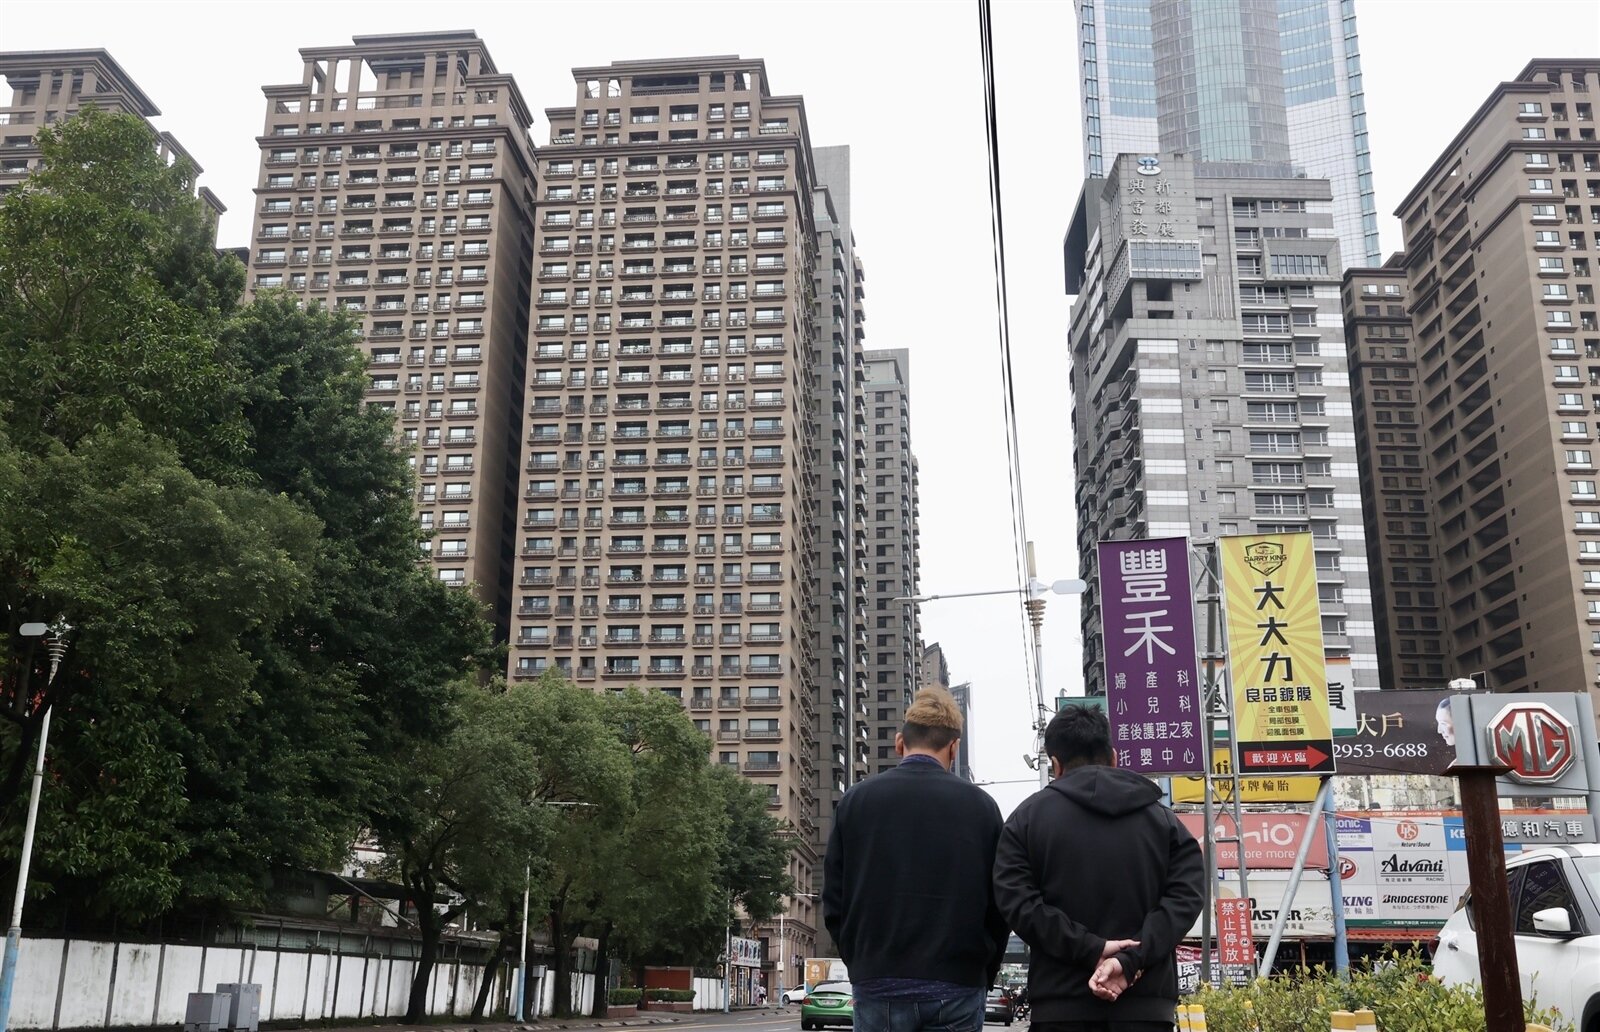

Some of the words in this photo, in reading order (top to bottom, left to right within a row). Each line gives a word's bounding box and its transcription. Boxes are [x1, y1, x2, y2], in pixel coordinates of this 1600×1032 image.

[1128, 178, 1147, 236] 興富發
[1155, 178, 1175, 238] 新都廳
[1270, 553, 1288, 562] KING
[1120, 549, 1176, 664] 豐禾
[1254, 581, 1293, 683] 大大力
[1115, 669, 1190, 690] 婦產科
[1246, 686, 1312, 703] 良品鍍膜
[1116, 695, 1192, 715] 小兒科
[1268, 705, 1299, 714] 全車包膜
[1118, 721, 1193, 741] 產後護理之家
[1333, 742, 1428, 758] 2953-6688
[1498, 711, 1567, 773] MG
[1119, 747, 1195, 767] 托嬰中心
[1252, 752, 1307, 763] 歡迎光臨
[1218, 779, 1290, 792] 國馬牌輪胎
[1501, 820, 1584, 838] 億和汽車
[1266, 850, 1295, 859] more
[1381, 853, 1443, 873] Advanti
[1342, 896, 1373, 907] KING
[1382, 894, 1449, 904] BRIDGESTONE
[1344, 907, 1374, 915] 京輪胎
[1221, 901, 1239, 962] 禁止停放
